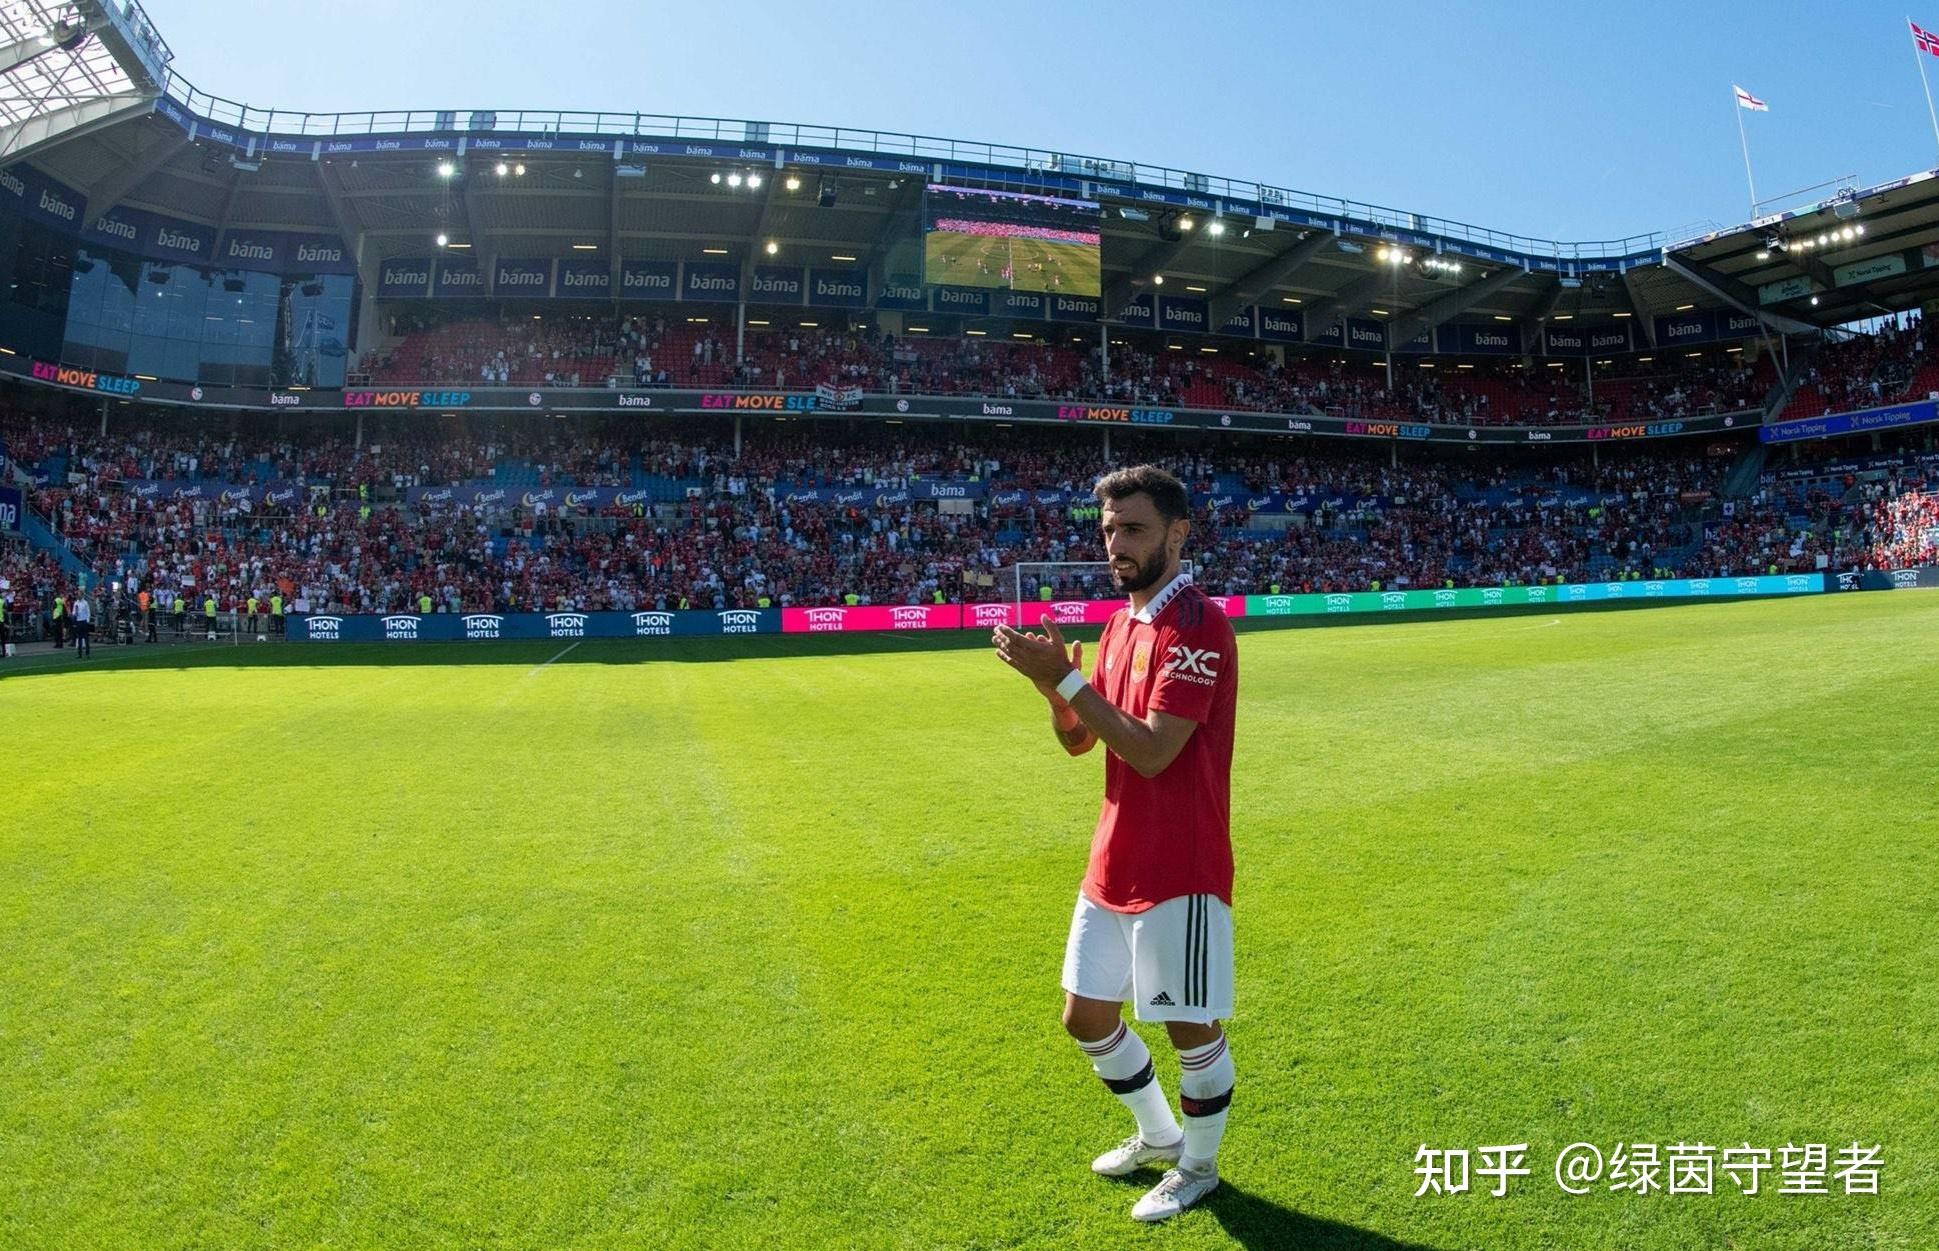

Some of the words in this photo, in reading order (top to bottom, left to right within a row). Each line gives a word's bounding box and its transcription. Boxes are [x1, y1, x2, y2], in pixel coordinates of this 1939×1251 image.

[33, 361, 57, 378] EAT
[57, 368, 97, 388] MOVE
[98, 376, 140, 394] SLEEP
[345, 392, 374, 406] EAT
[375, 392, 420, 405] MOVE
[423, 392, 470, 405] SLEEP
[702, 395, 734, 408] EAT
[735, 396, 784, 408] MOVE
[787, 396, 816, 410] SLE
[1058, 406, 1086, 419] EAT
[1087, 408, 1129, 421] MOVE
[1131, 410, 1173, 423] SLEEP
[1346, 422, 1367, 433] EAT
[1368, 424, 1399, 435] MOVE
[1400, 425, 1430, 437] SLEEP
[1587, 429, 1610, 439] EAT
[1611, 426, 1646, 438] MOVE
[1647, 423, 1683, 434] SLEEP
[1891, 569, 1920, 581] THON
[1263, 595, 1294, 607] THON
[1323, 593, 1353, 605] THON
[1381, 591, 1407, 602] THON
[1433, 590, 1458, 600] THON
[717, 610, 761, 624] THON
[804, 607, 848, 622] THON
[889, 606, 931, 620] THON
[971, 604, 1012, 618] THON
[305, 615, 343, 630] THON
[381, 615, 422, 630] THON
[461, 614, 504, 629] THON
[545, 613, 589, 627] THON
[630, 611, 675, 626] THON
[467, 630, 499, 638] HOTELS
